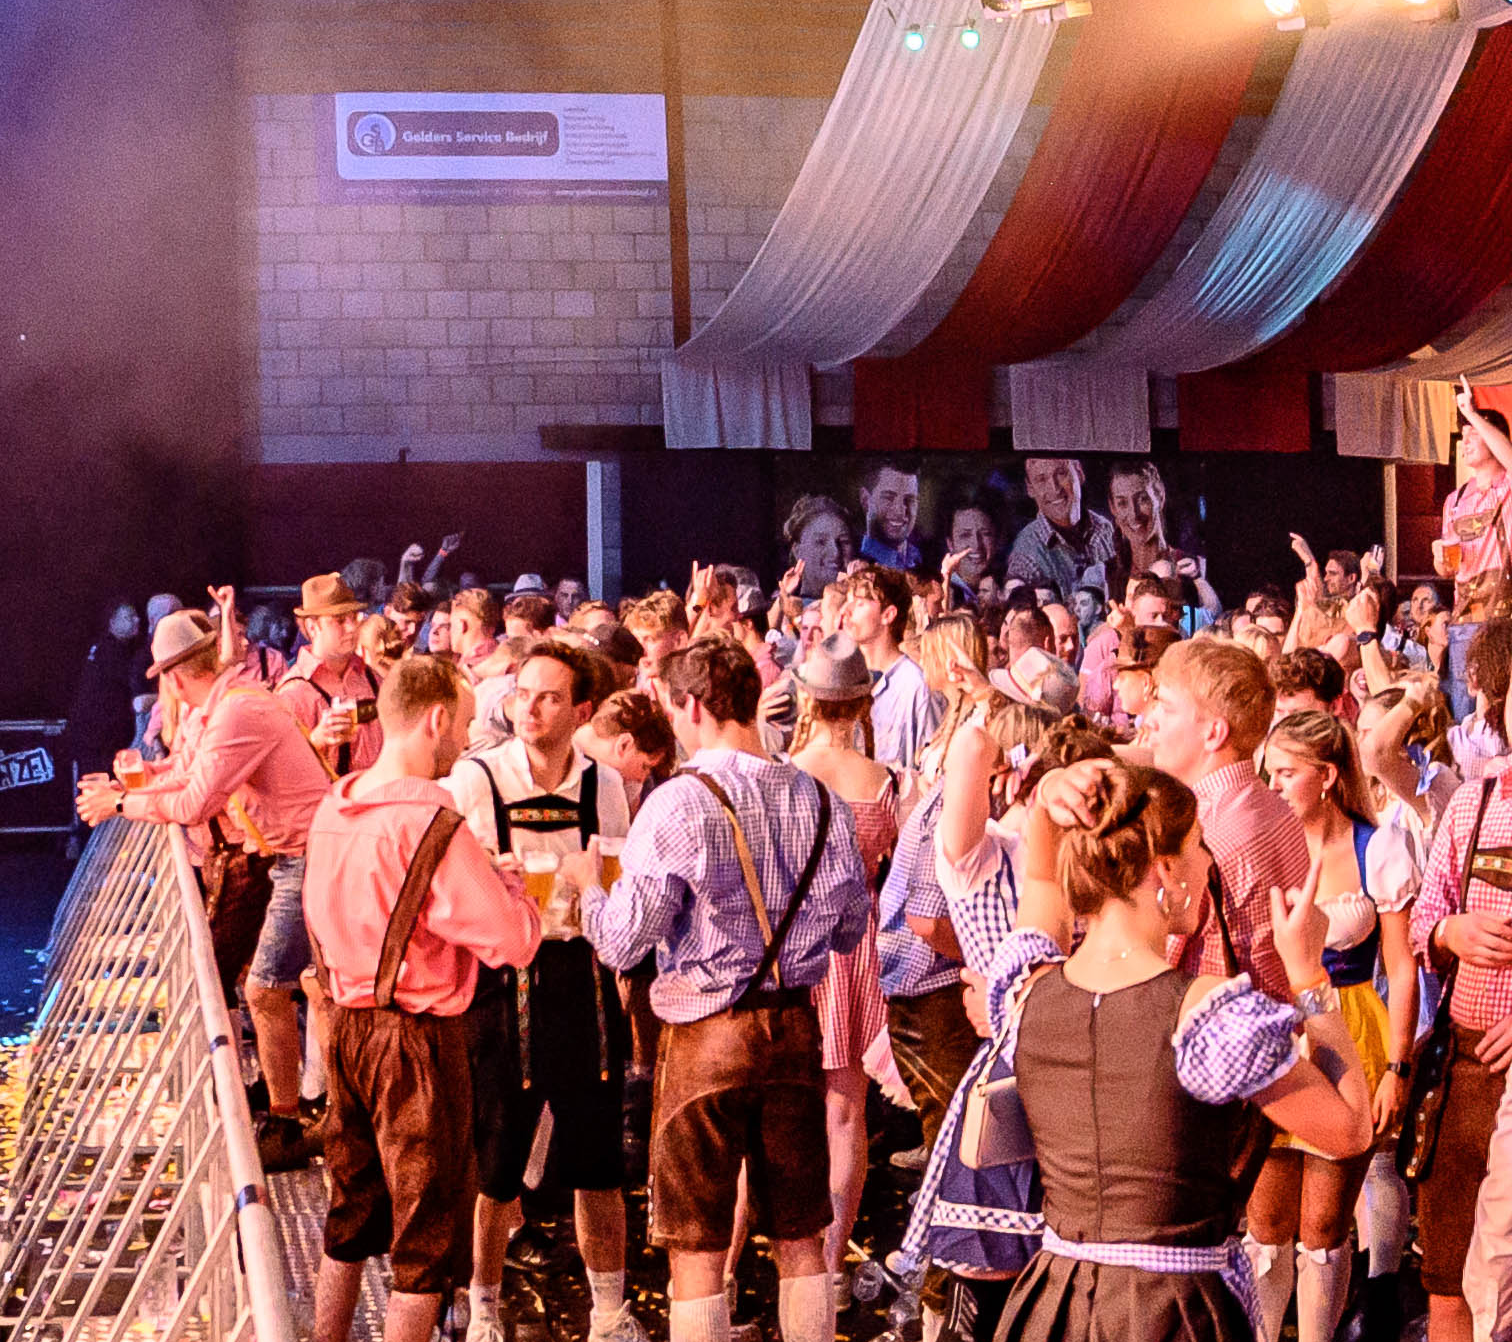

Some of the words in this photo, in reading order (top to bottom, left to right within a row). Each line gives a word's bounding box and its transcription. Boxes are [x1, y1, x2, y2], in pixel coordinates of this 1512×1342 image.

[402, 130, 452, 143] Gelders
[456, 130, 502, 143] Service
[506, 130, 549, 146] Bedrijf
